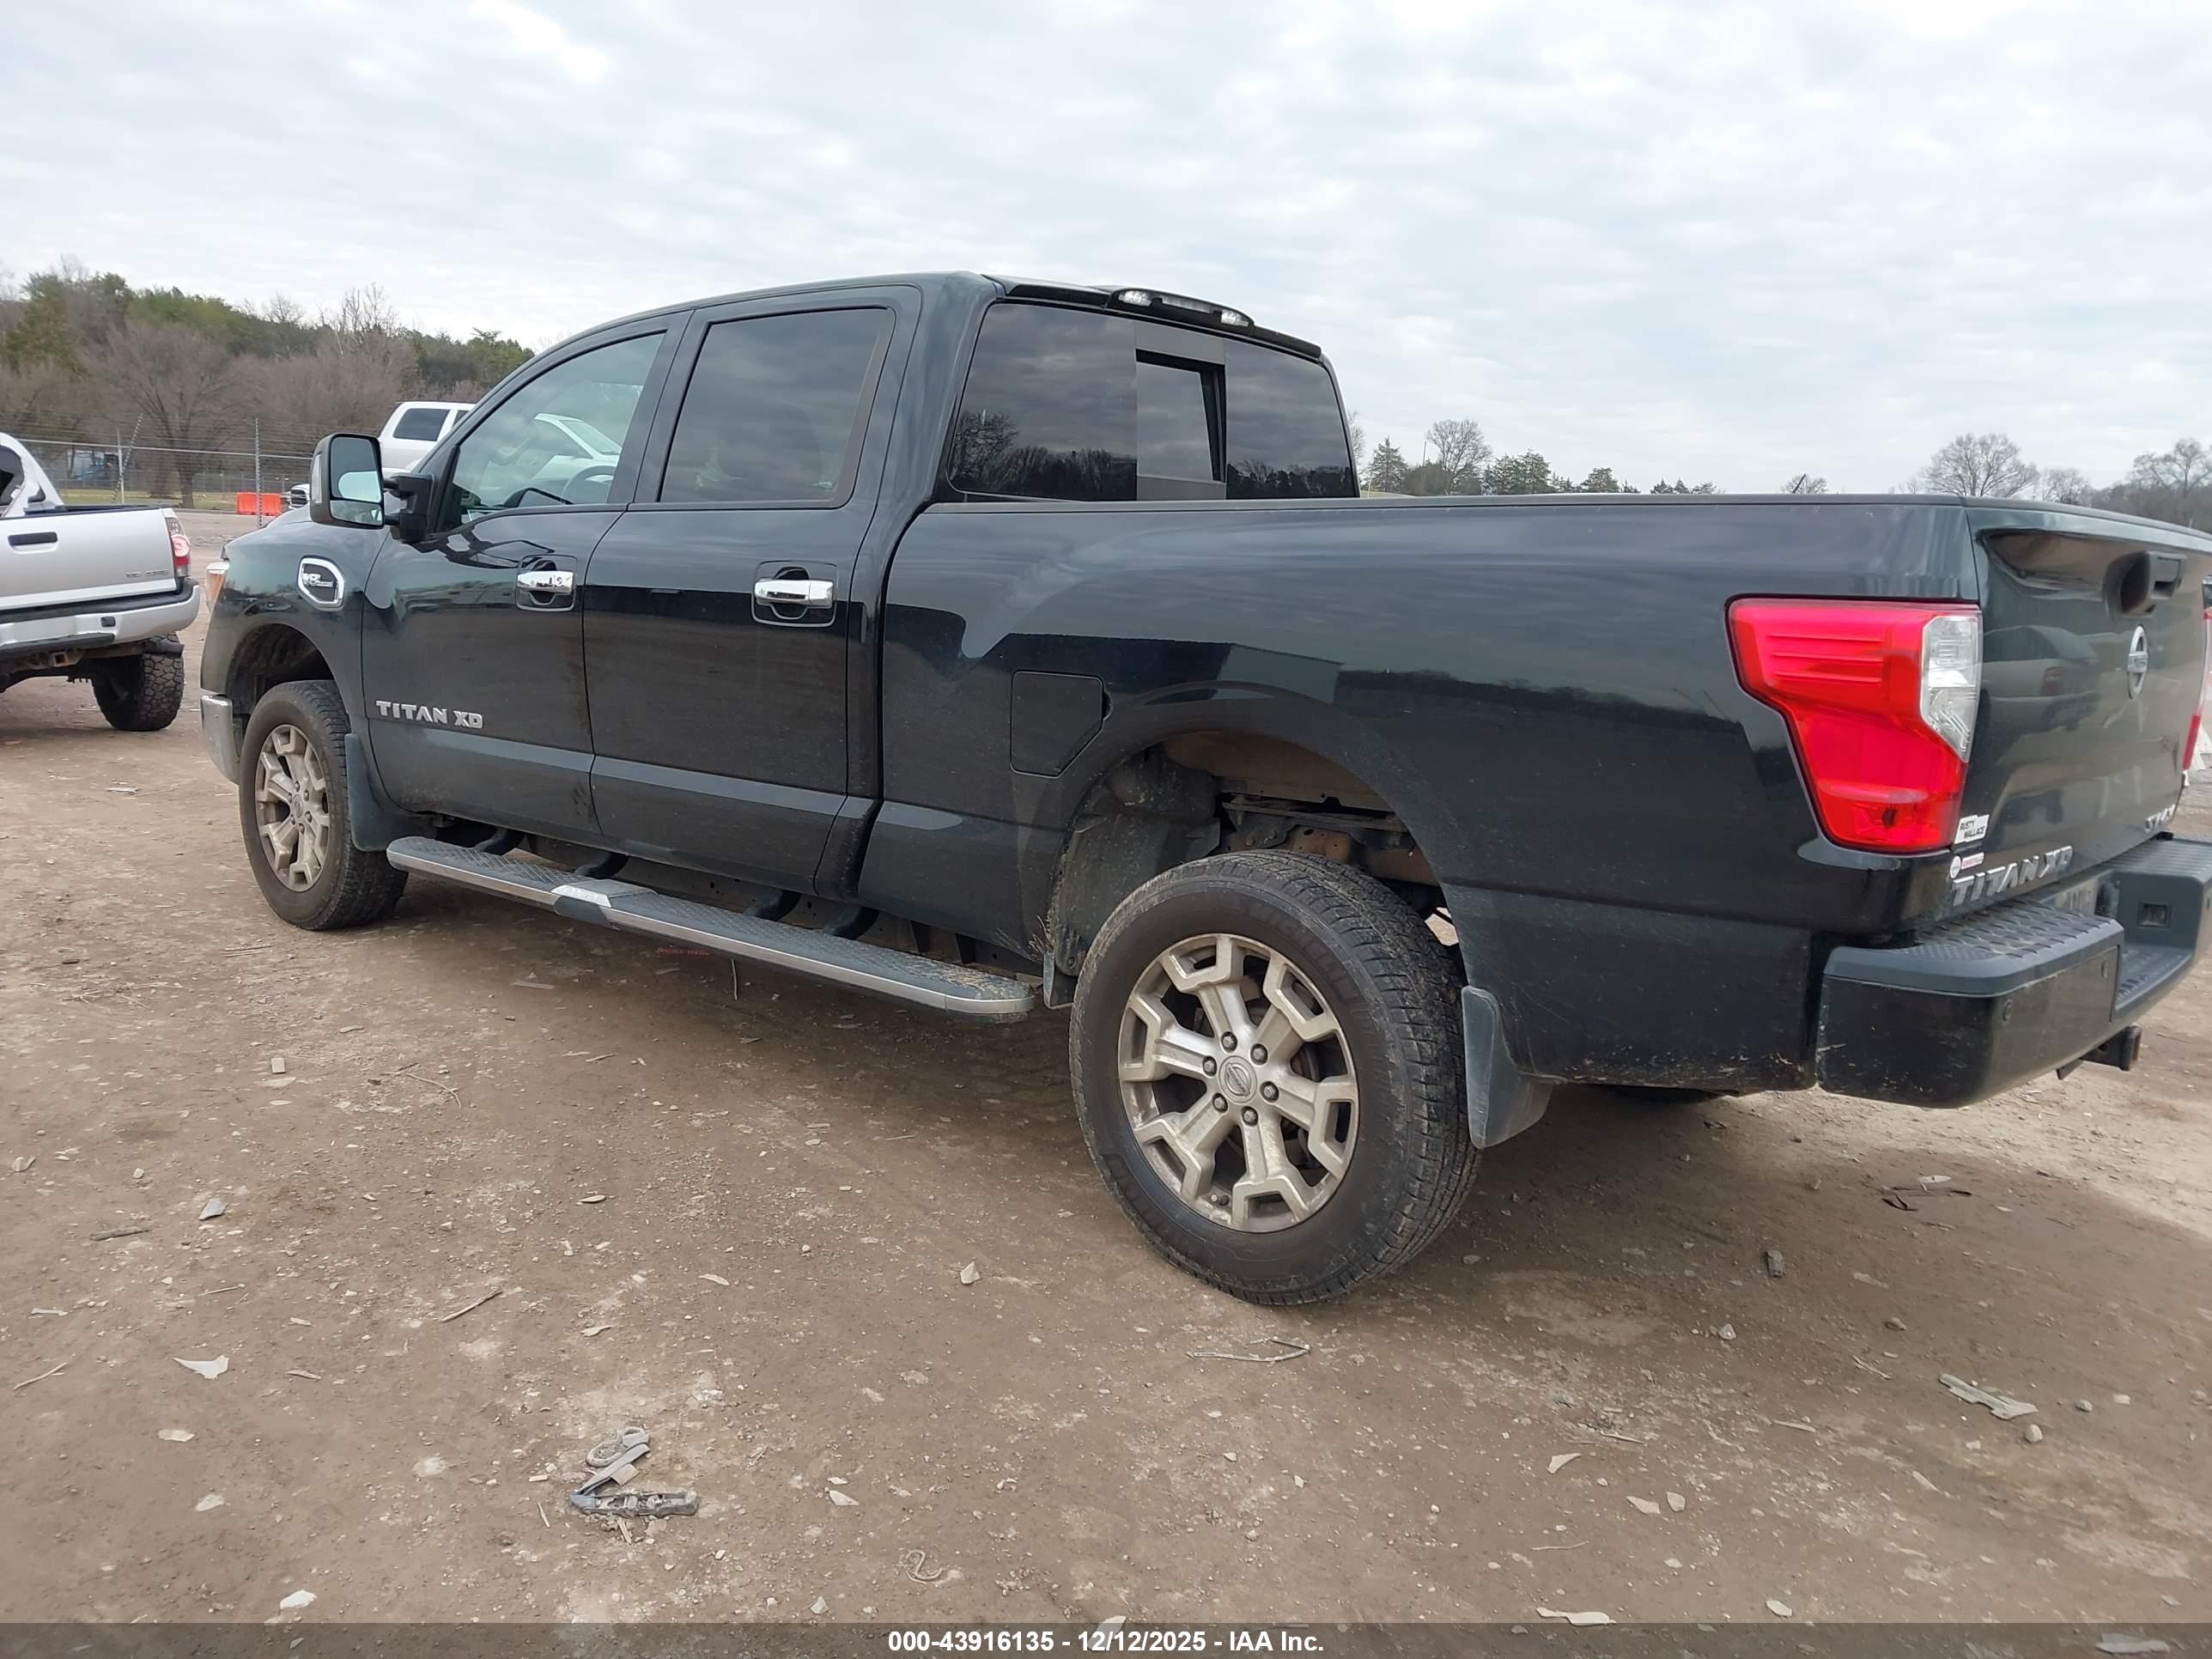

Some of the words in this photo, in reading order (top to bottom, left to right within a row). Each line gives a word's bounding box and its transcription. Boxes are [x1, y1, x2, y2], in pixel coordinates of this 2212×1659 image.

[375, 700, 447, 725] TITAN
[453, 710, 483, 729] XD
[1952, 854, 2040, 907] TITAN
[2038, 845, 2074, 878] XD
